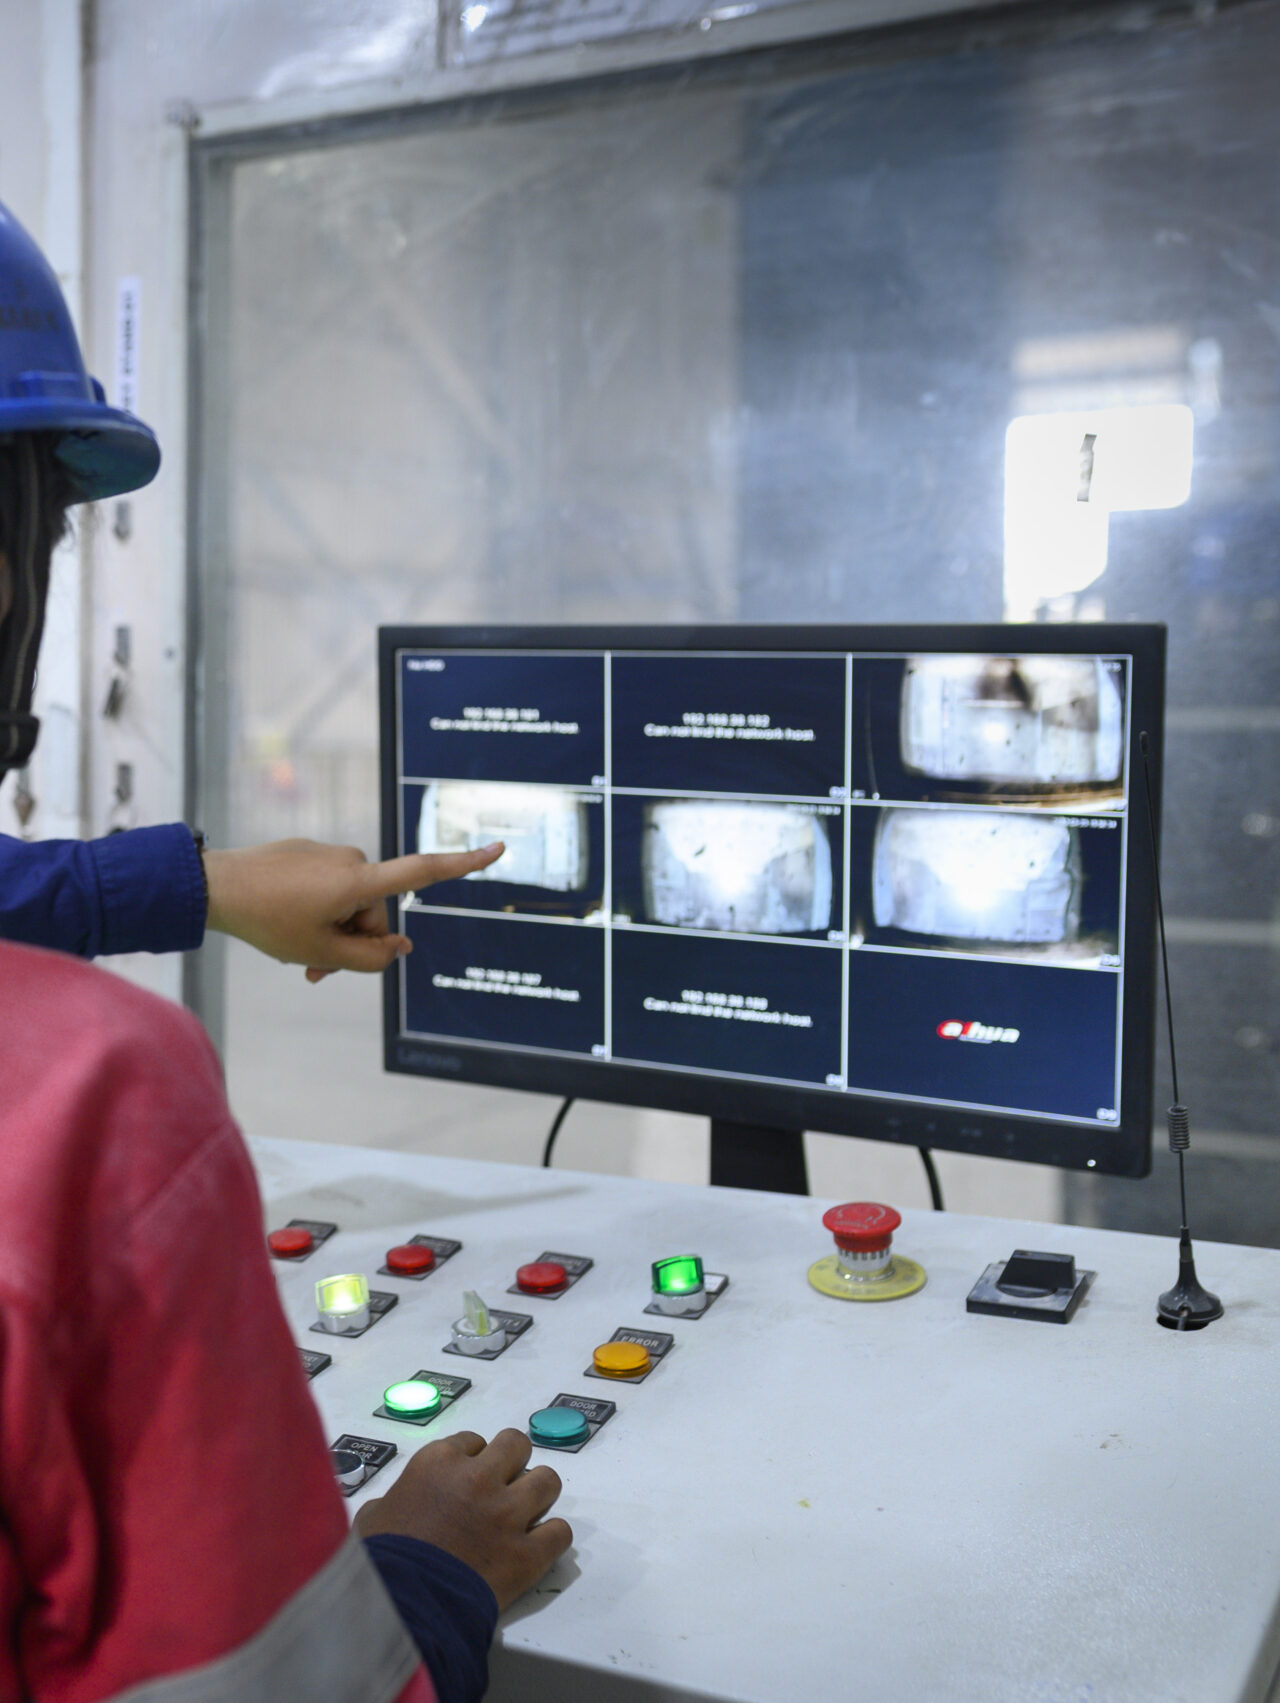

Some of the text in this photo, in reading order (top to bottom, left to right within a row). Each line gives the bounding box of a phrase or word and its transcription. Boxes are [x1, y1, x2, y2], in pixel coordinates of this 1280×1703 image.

[621, 1335, 659, 1348] ERROR
[569, 1400, 597, 1410] DOOR
[351, 1442, 379, 1452] OPEN
